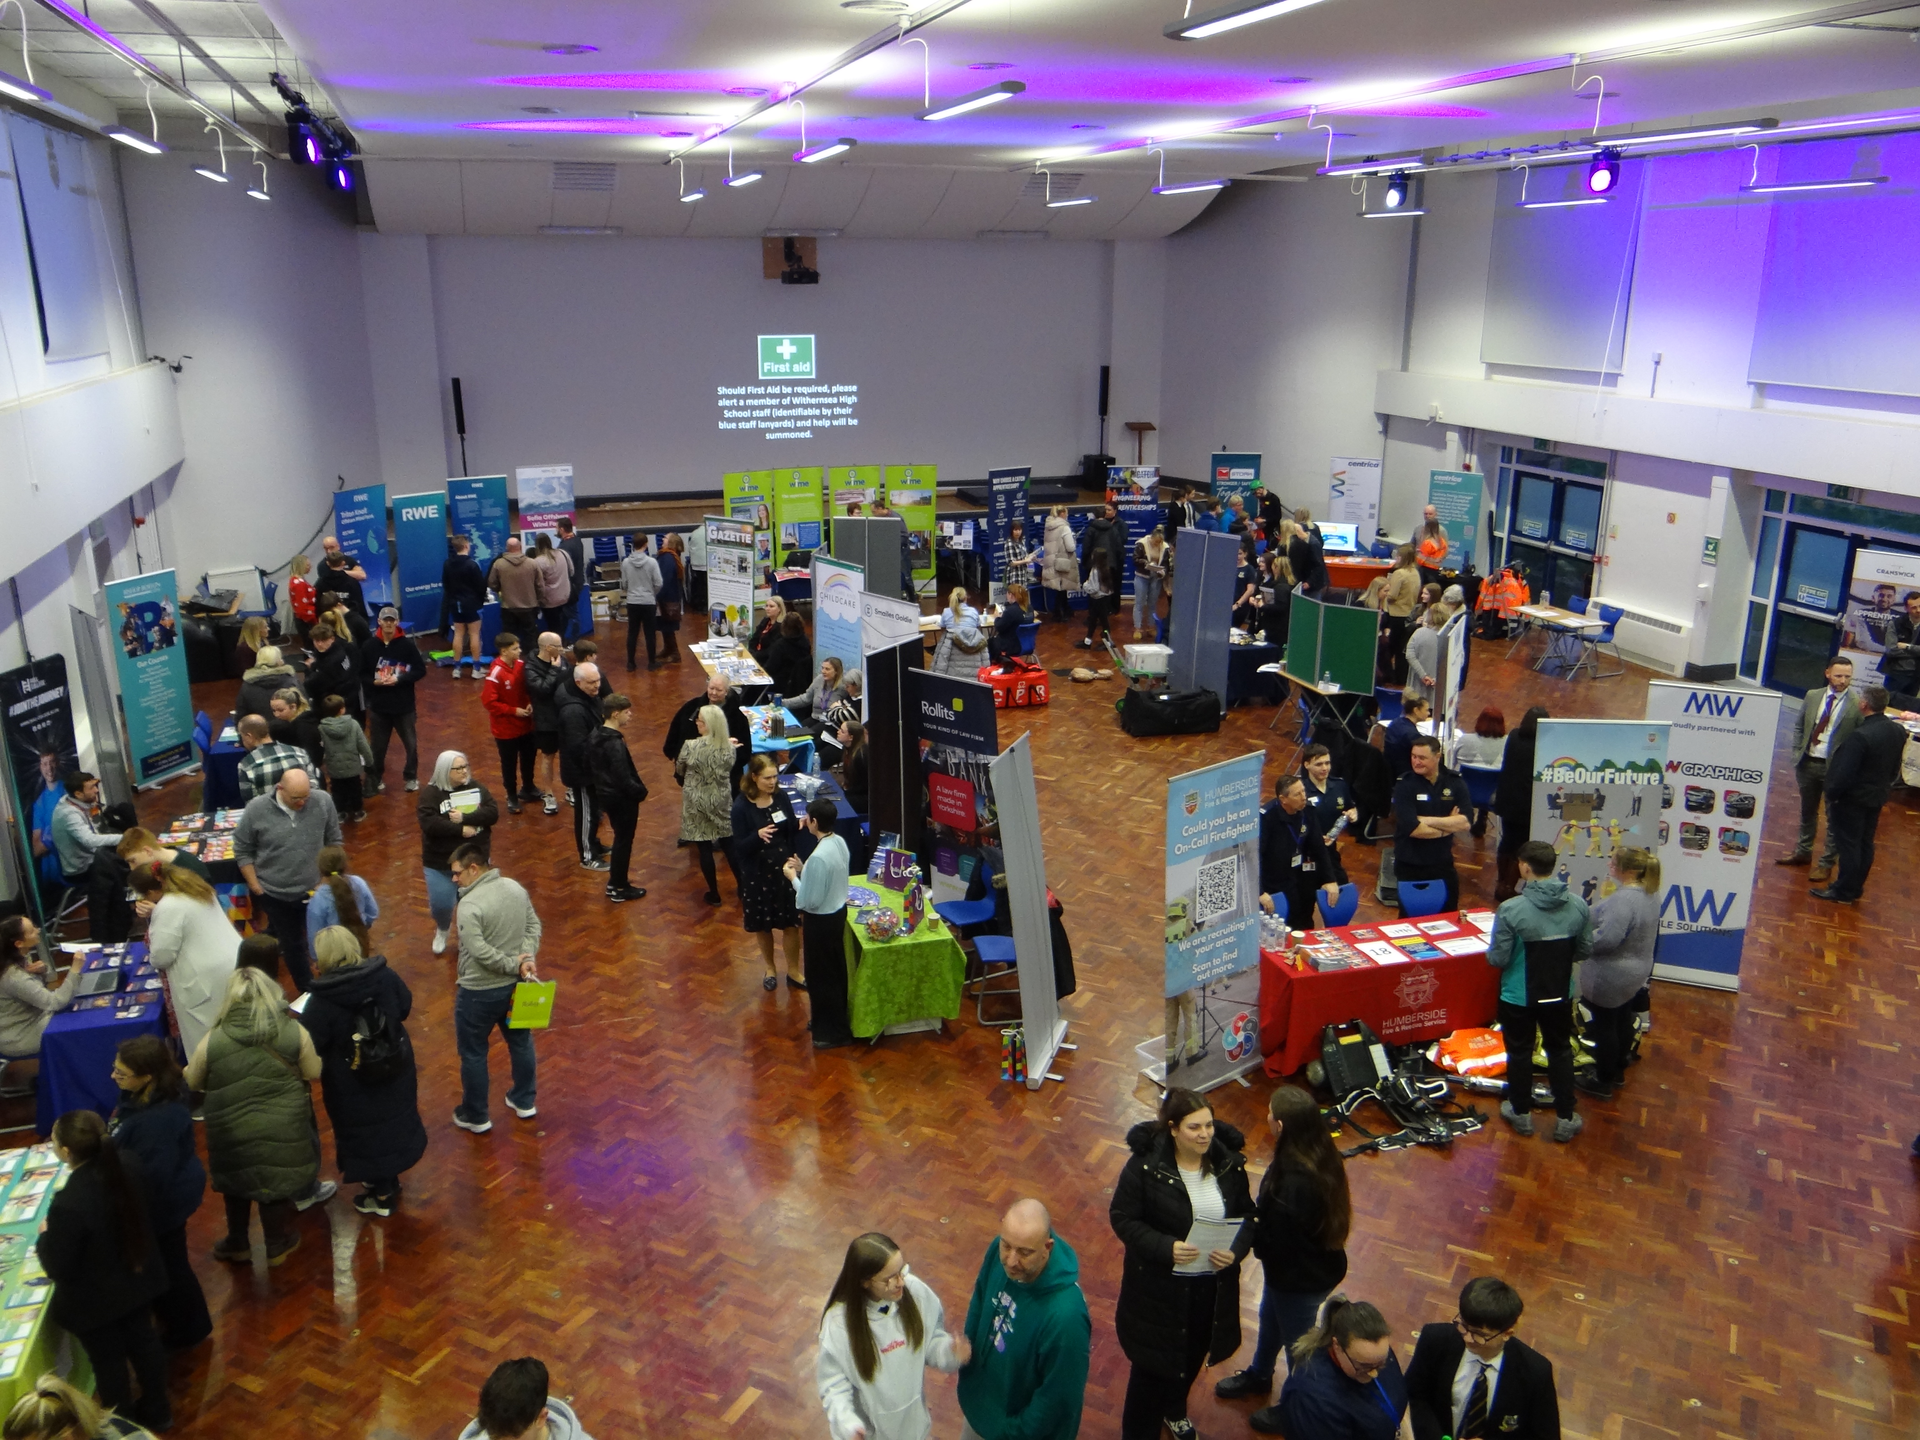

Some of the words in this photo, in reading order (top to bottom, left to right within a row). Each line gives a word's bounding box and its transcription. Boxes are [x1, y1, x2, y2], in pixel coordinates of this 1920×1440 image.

[763, 362, 790, 373] First
[792, 361, 811, 373] aid
[716, 386, 746, 395] Should
[747, 386, 765, 395] First
[766, 385, 781, 394] Aid
[782, 385, 792, 394] be
[794, 384, 830, 396] required,
[832, 384, 858, 395] please
[717, 398, 737, 407] alert
[746, 397, 780, 406] member
[781, 397, 791, 405] of
[791, 396, 838, 405] Withernsea
[839, 395, 857, 406] High
[723, 409, 751, 418] School
[752, 408, 770, 417] staff
[772, 407, 820, 418] (identifiable
[822, 407, 832, 417] by
[833, 406, 853, 415] their
[718, 421, 737, 430] blue
[738, 420, 757, 429] staff
[758, 419, 794, 430] lanyards)
[796, 419, 811, 427] and
[813, 418, 830, 428] help
[832, 418, 846, 426] will
[847, 417, 858, 426] be
[765, 430, 813, 440] summoned.
[353, 493, 369, 503] RWE
[1216, 486, 1251, 503] Together
[401, 505, 439, 522] RWE
[526, 514, 542, 522] Sofia
[708, 525, 752, 544] GAZETTE
[1876, 568, 1915, 578] CRANSWICK
[819, 591, 856, 609] CHILDCARE
[895, 613, 913, 623] Goldie
[921, 700, 955, 721] Rollits
[1683, 691, 1744, 718] MW
[922, 722, 937, 730] YOUR
[937, 725, 950, 734] KIND
[960, 730, 970, 738] LAW
[971, 733, 984, 742] FIRM
[1671, 722, 1696, 731] roudly
[1697, 725, 1737, 734] partnered
[1541, 767, 1660, 786] #BeOurFuture
[1681, 762, 1763, 784] GRAPHICS
[942, 787, 954, 796] law
[953, 789, 967, 800] firm
[1204, 775, 1259, 801] HUMBERSIDE
[936, 794, 956, 806] made
[956, 799, 963, 807] in
[1204, 800, 1215, 809] Fire
[1216, 798, 1220, 806] &
[1220, 793, 1240, 805] Rescue
[1240, 787, 1259, 798] Service
[937, 802, 967, 818] Yorkshire.
[1182, 819, 1207, 837] Could
[1208, 816, 1225, 830] you
[1227, 811, 1237, 822] be
[1239, 808, 1251, 818] an
[1174, 834, 1208, 855] On-Call
[1210, 817, 1258, 843] Firefighter?
[1178, 940, 1192, 952] We
[1192, 936, 1206, 946] are
[1208, 922, 1246, 941] recruiting
[1246, 917, 1255, 926] in
[1676, 922, 1733, 937] SOLUTIONS
[1195, 942, 1214, 958] your
[1216, 935, 1237, 948] area.
[1192, 961, 1212, 974] Scan
[1212, 957, 1221, 966] to
[1222, 948, 1238, 962] find
[1196, 969, 1211, 981] out
[1211, 962, 1235, 976] more.
[1382, 1008, 1447, 1029] HUMBERSIDE
[1382, 1027, 1394, 1035] Fire
[1401, 1022, 1422, 1031] Rescue
[1423, 1018, 1447, 1028] Service
